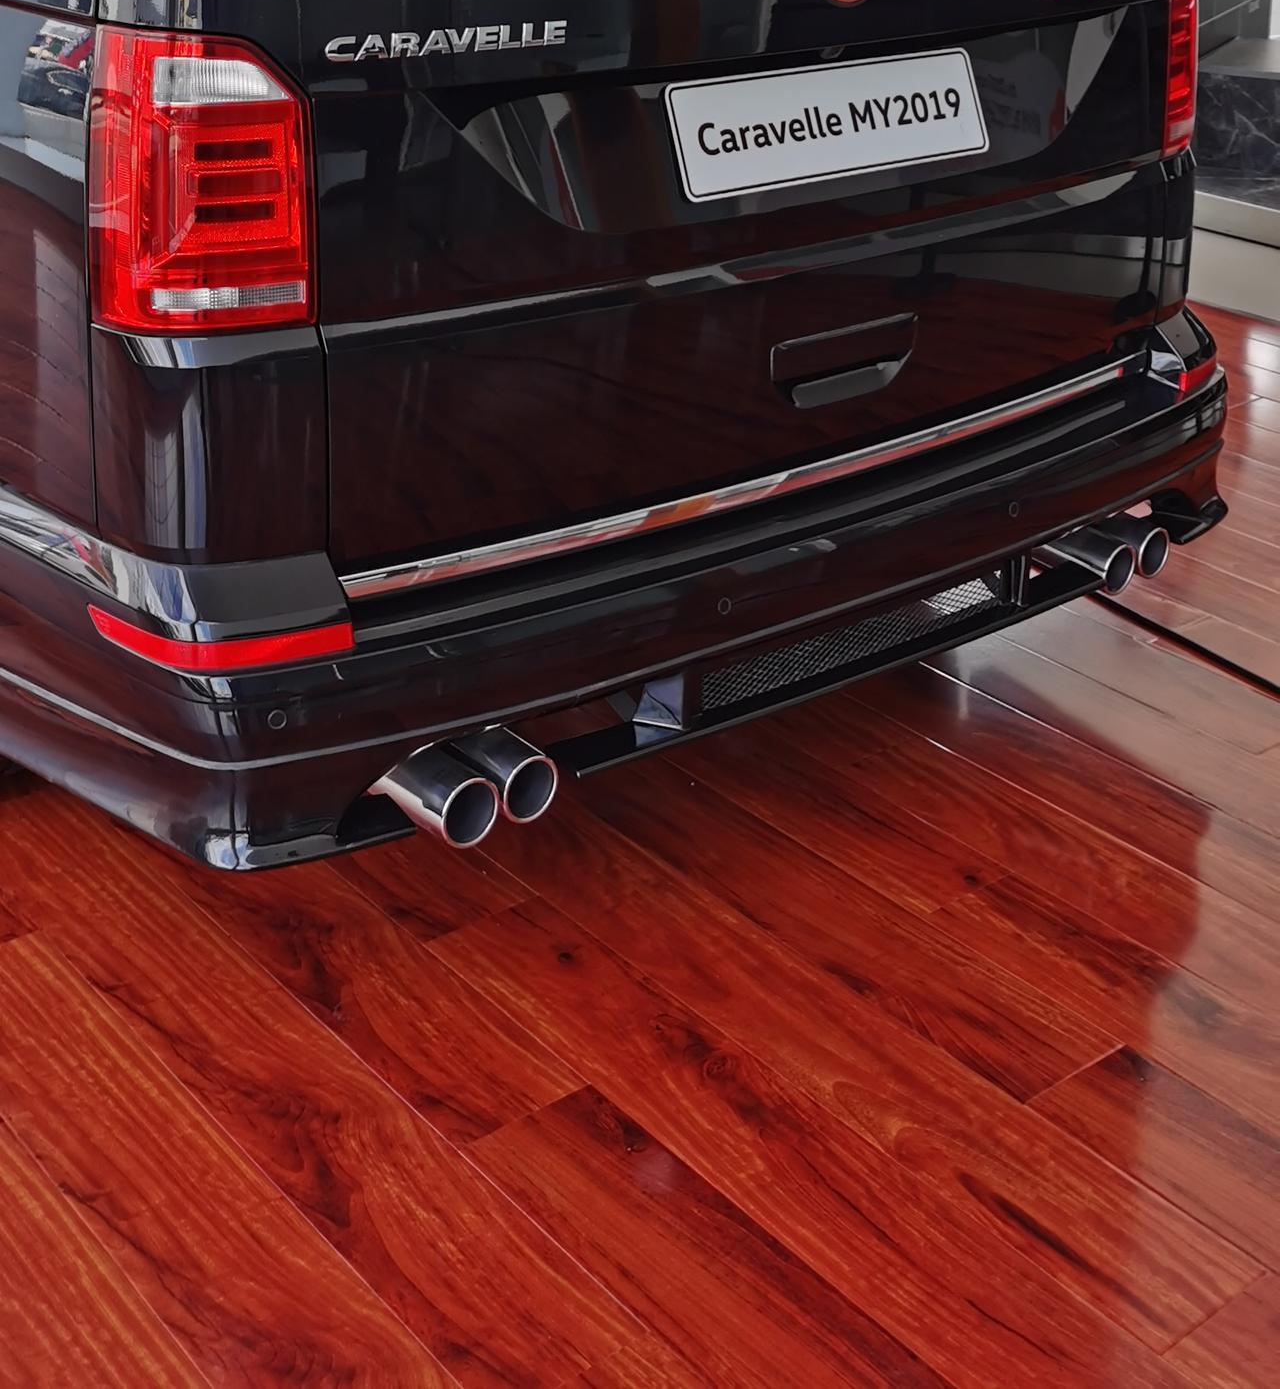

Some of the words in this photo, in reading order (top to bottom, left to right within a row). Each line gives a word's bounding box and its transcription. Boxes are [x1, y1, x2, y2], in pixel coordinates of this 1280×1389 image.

[324, 20, 568, 62] CARAVELLE
[697, 107, 843, 156] Caravelle
[847, 87, 961, 133] MY2019
